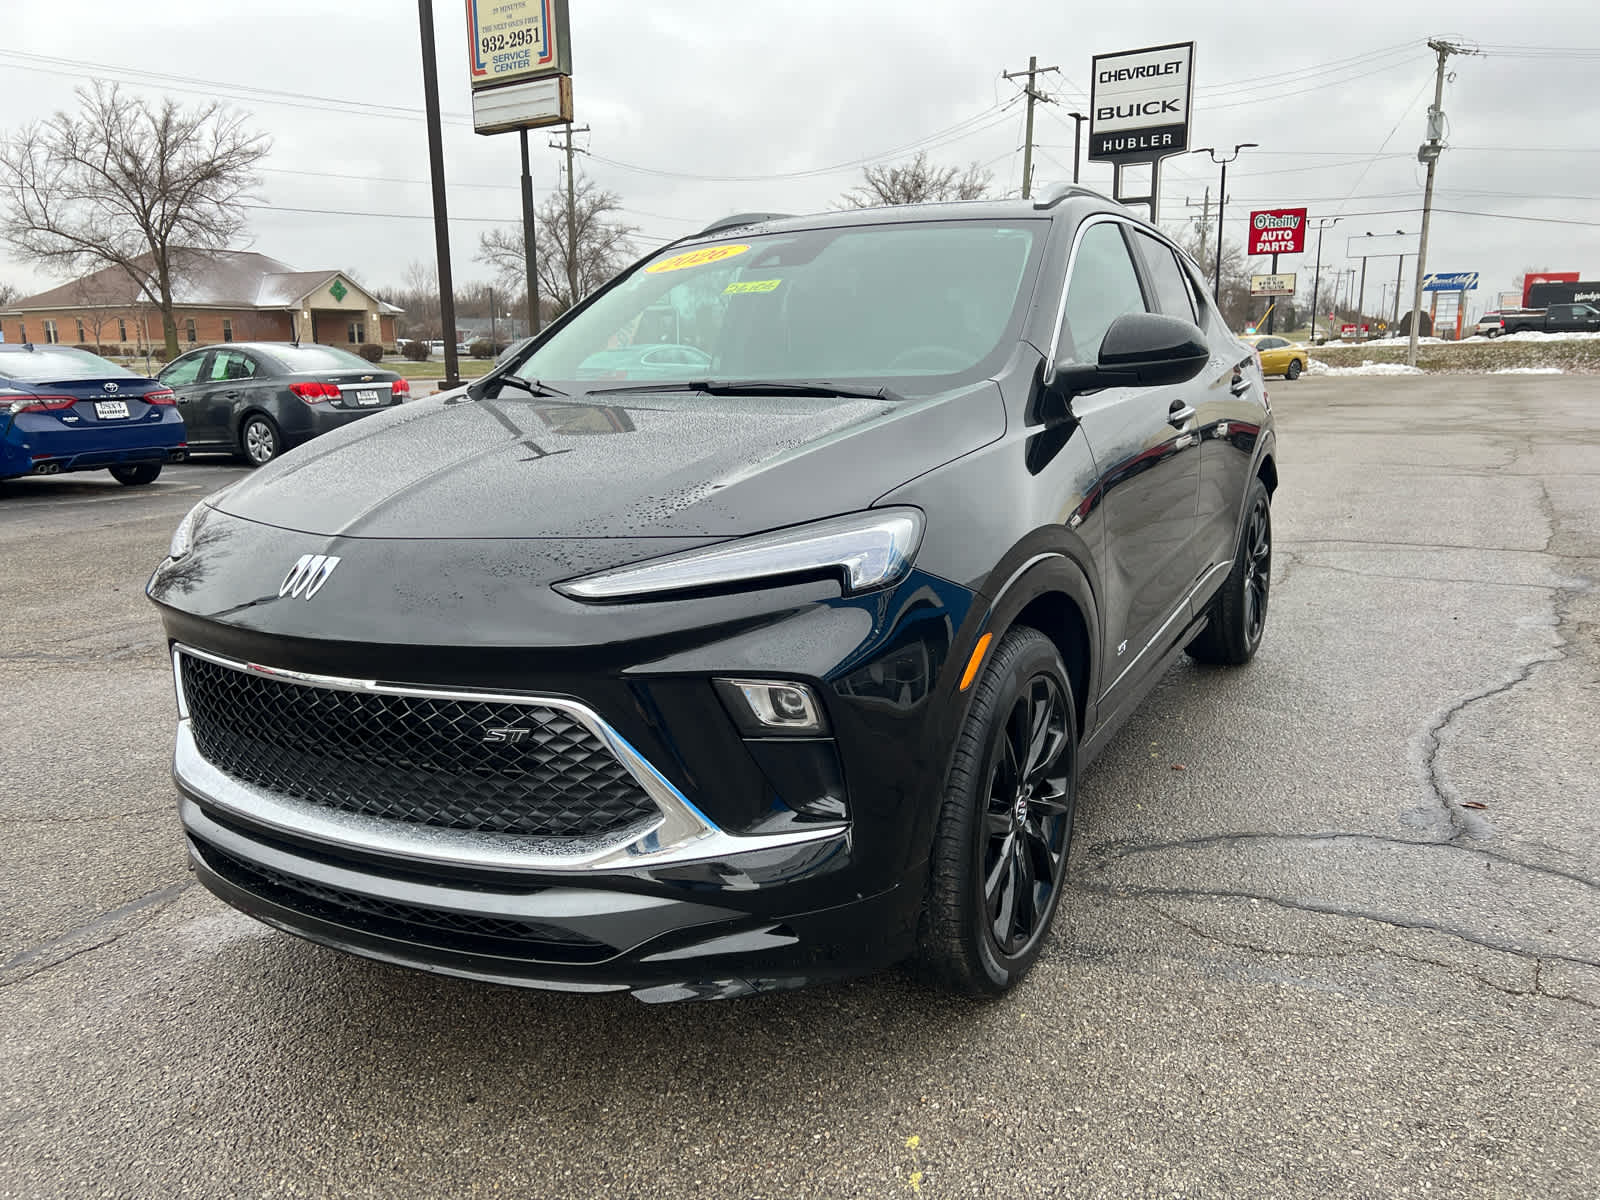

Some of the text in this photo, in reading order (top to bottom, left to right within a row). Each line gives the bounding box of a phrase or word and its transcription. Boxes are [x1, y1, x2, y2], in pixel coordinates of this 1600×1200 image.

[482, 27, 540, 53] 932-2951
[492, 49, 530, 63] SERVICE
[494, 59, 530, 73] CENTER
[1099, 61, 1182, 83] CHEVROLET
[1097, 99, 1181, 120] BUICK
[1103, 134, 1172, 151] HUBLER
[1254, 214, 1300, 229] O'Reilly
[1261, 230, 1293, 241] AUTO
[1256, 241, 1294, 252] PARTS
[483, 728, 530, 743] ST
